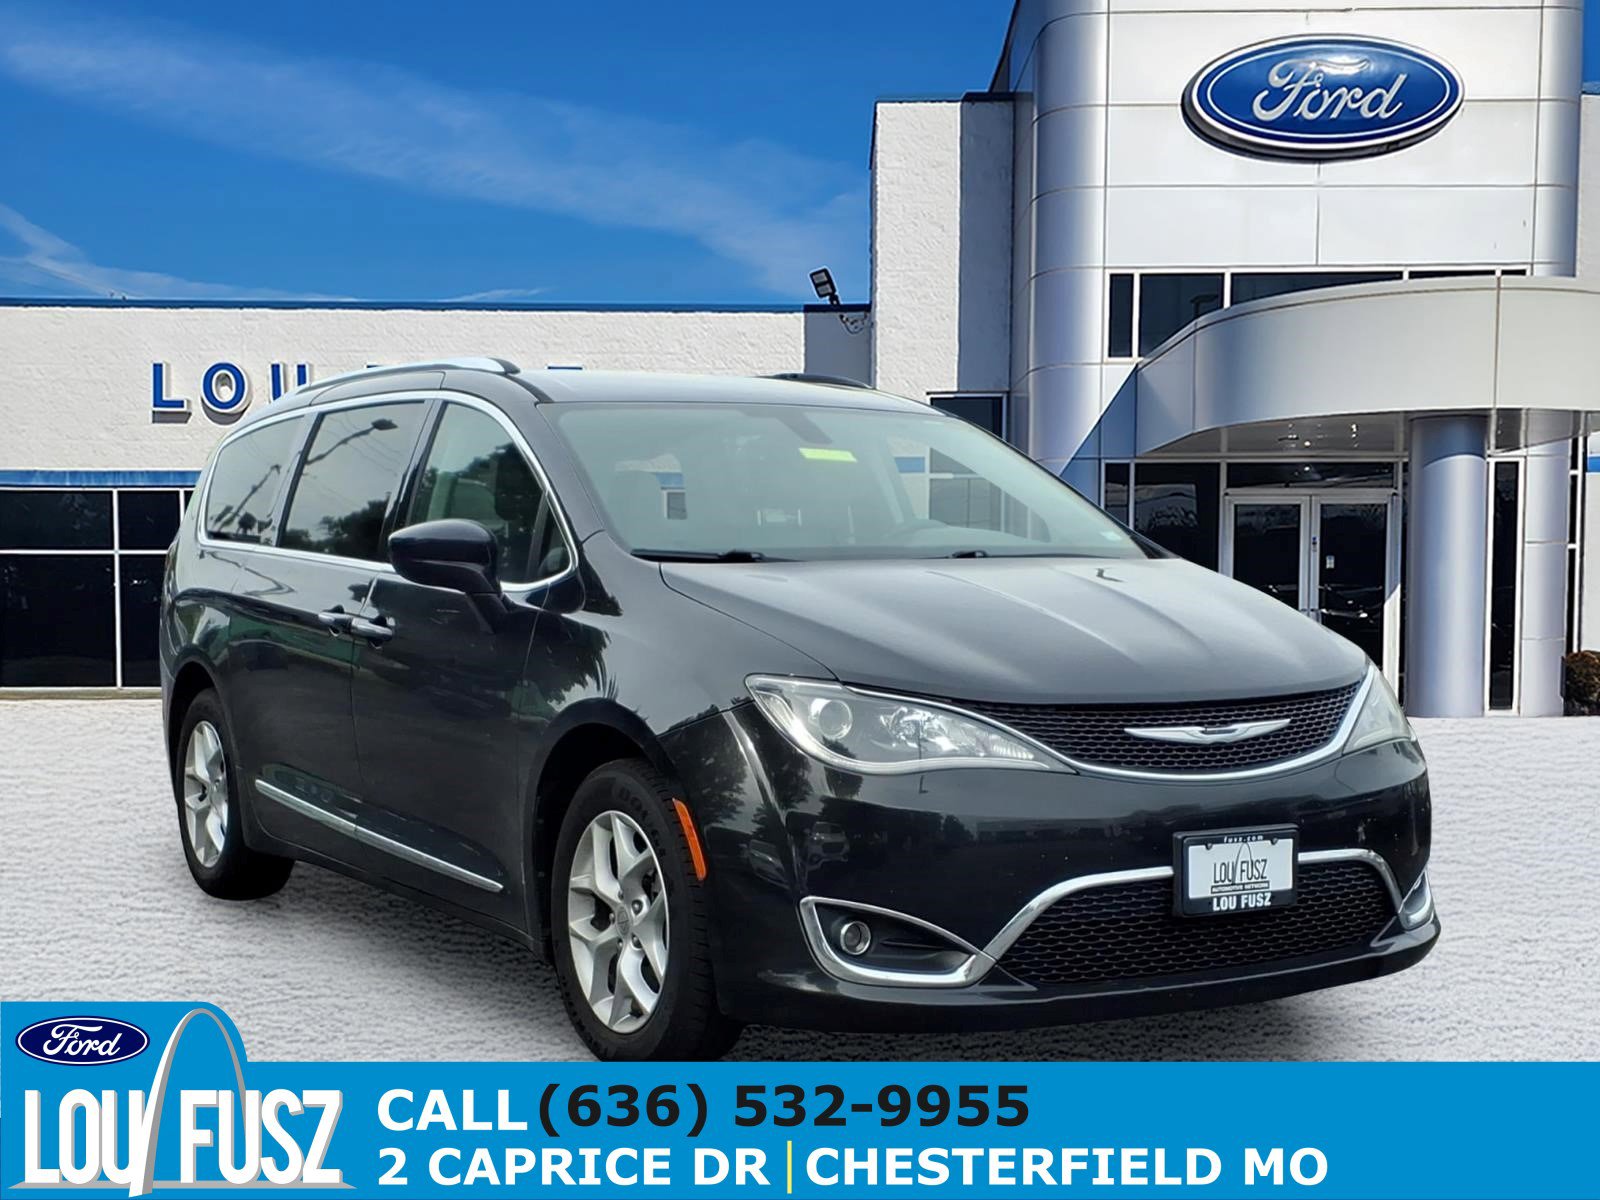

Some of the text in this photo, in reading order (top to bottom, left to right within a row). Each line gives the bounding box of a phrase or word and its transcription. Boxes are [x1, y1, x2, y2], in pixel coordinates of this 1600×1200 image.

[1252, 58, 1408, 121] Ford
[1213, 859, 1268, 884] LOU FUSZ
[1213, 892, 1271, 911] LOU FUSZ
